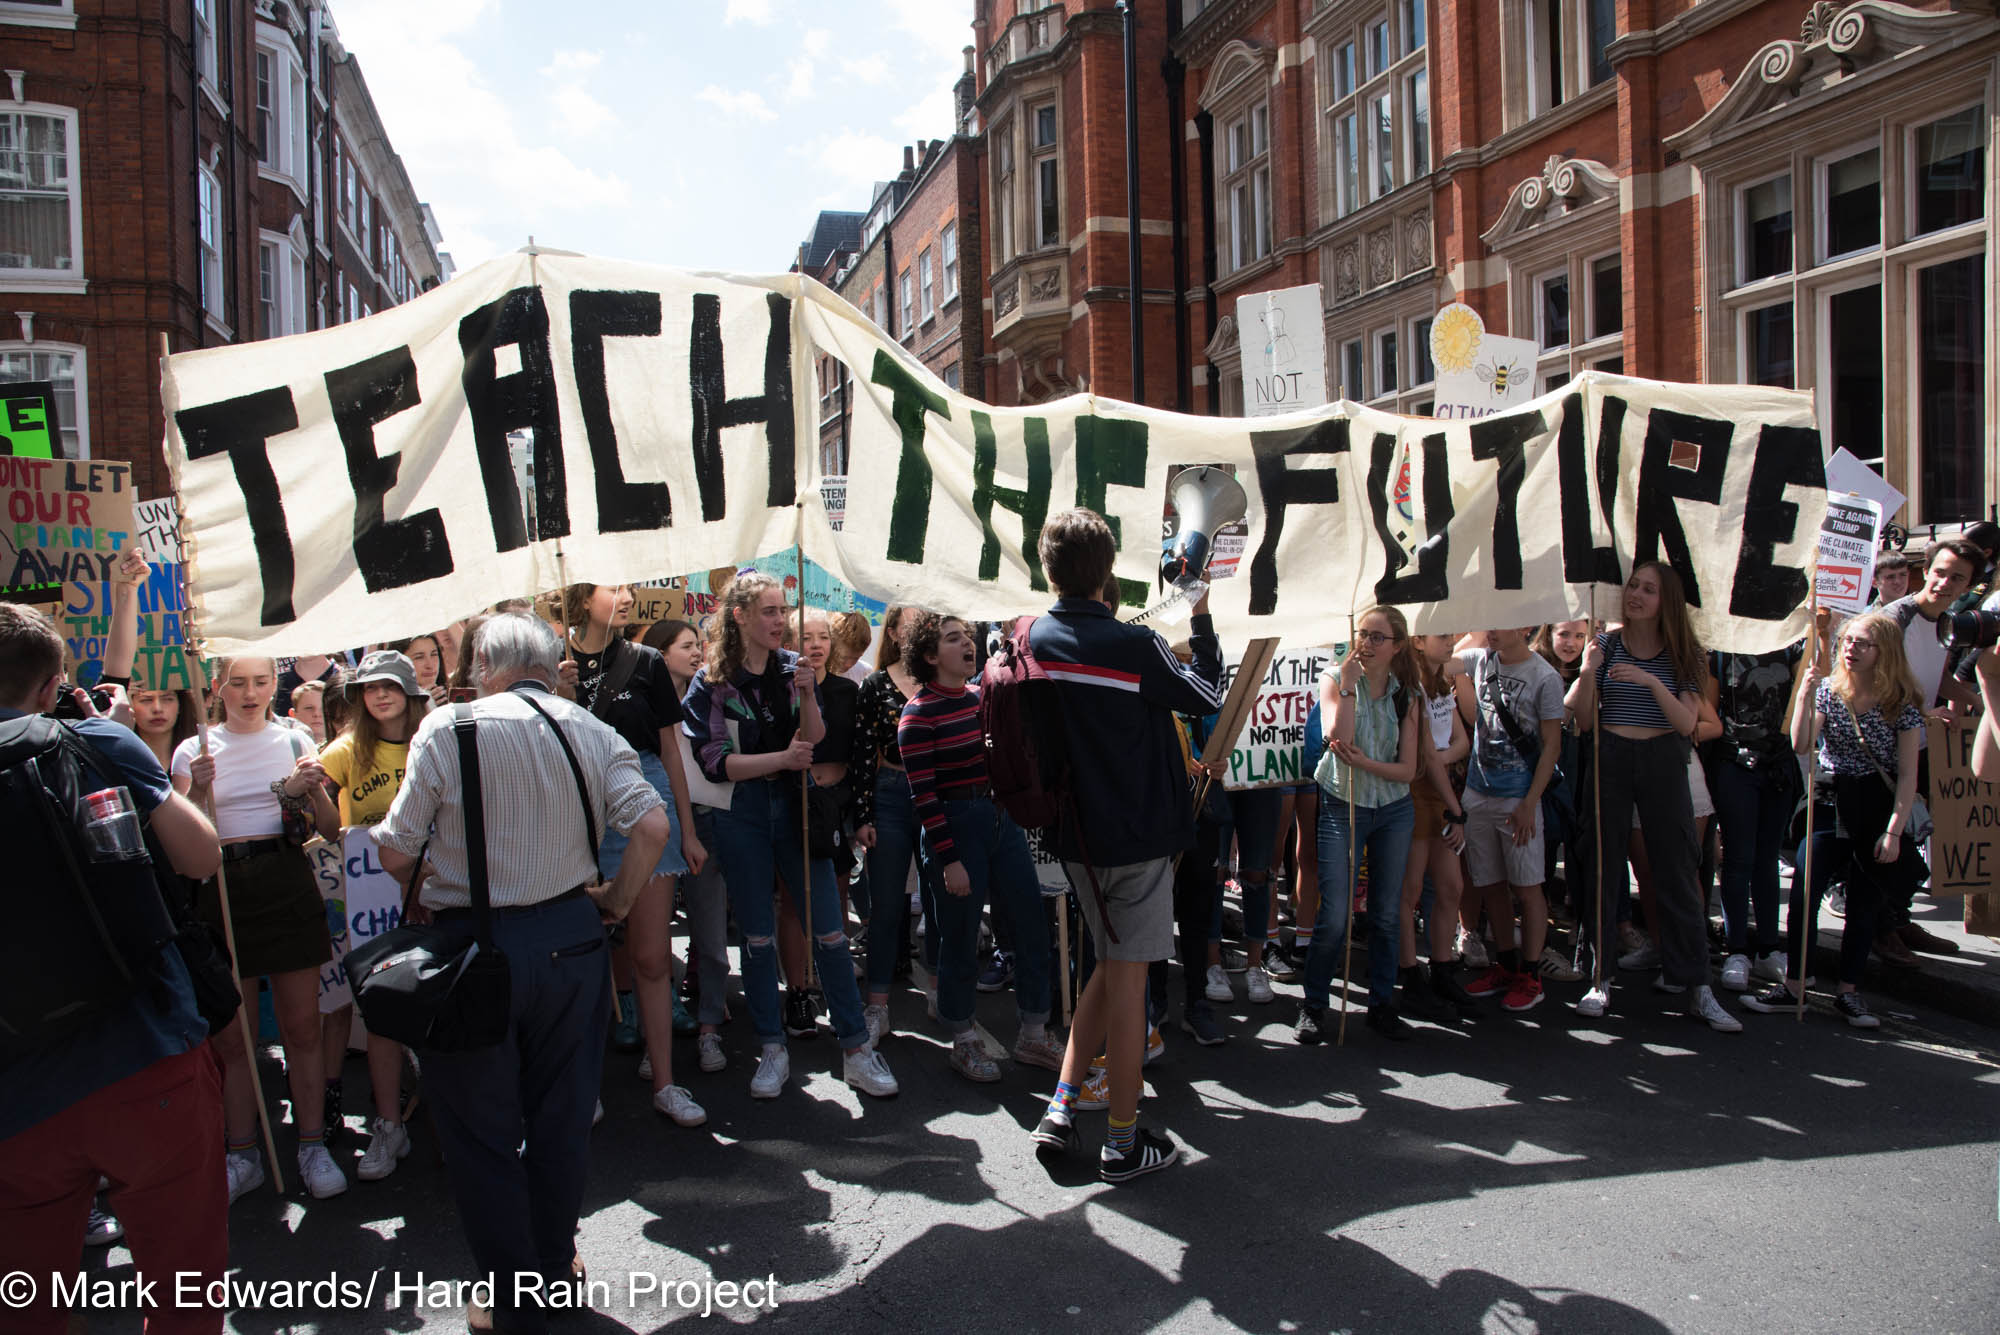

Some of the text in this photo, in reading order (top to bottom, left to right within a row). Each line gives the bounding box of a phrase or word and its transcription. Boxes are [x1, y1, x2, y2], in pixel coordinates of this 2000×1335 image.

[1255, 372, 1304, 404] NOT
[175, 284, 796, 627] TEACH
[65, 461, 130, 493] LET
[870, 347, 1151, 608] THE
[8, 489, 92, 526] OUR
[1248, 391, 1828, 621] FUTURE
[138, 524, 179, 553] TH
[829, 520, 844, 532] AT
[1831, 519, 1860, 535] TRUMP
[1833, 538, 1865, 553] CLIMATE
[9, 547, 118, 586] AWAY
[64, 615, 112, 637] TH
[638, 600, 672, 620] WE?
[66, 637, 107, 660] YO
[1225, 655, 1329, 690] FK THE
[1250, 724, 1304, 746] NOT THE
[1945, 727, 1974, 769] IF
[1229, 746, 1305, 783] PLAN
[352, 773, 390, 802] CAMP
[346, 847, 384, 879] CL
[1943, 841, 1992, 880] WE
